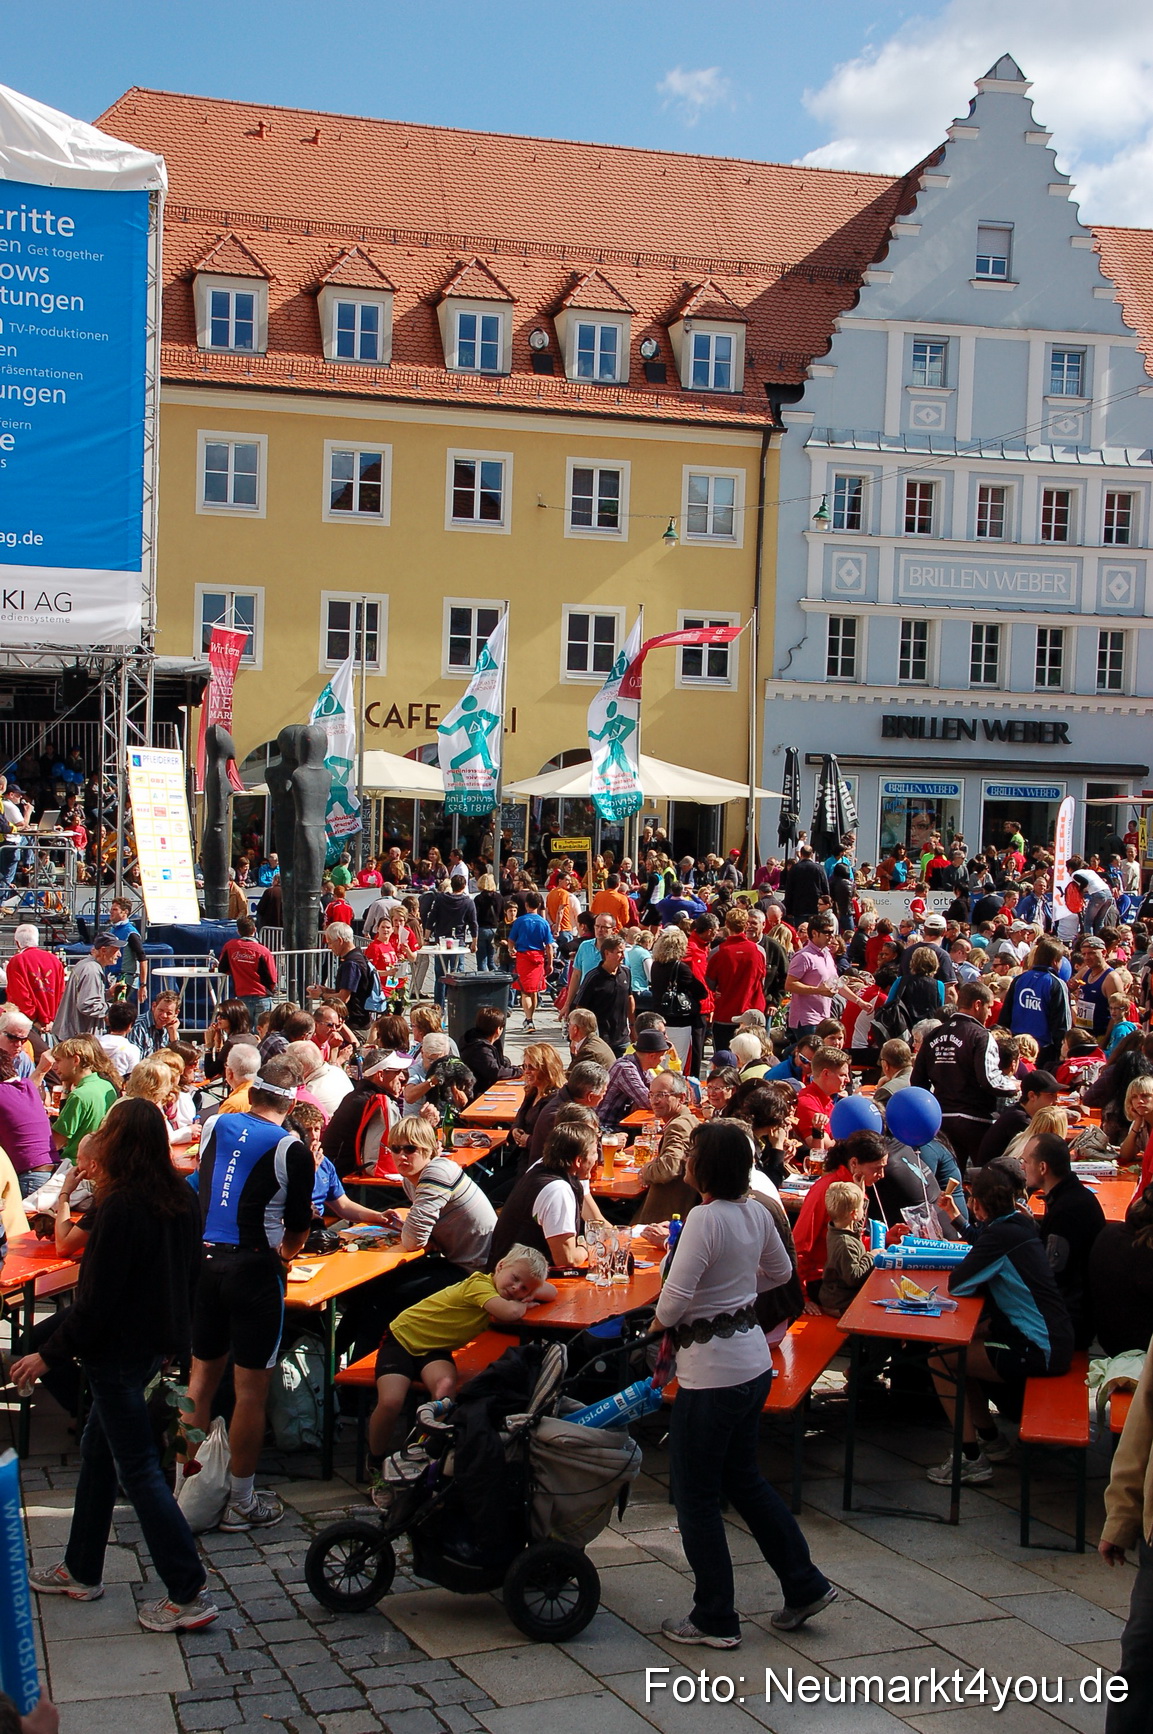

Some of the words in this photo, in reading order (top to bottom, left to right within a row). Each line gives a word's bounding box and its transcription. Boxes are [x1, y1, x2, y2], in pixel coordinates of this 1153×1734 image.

[27, 244, 49, 256] Get
[52, 247, 104, 262] together
[0, 263, 50, 283] ows
[9, 322, 109, 341] TV-Produktionen
[1, 364, 84, 380] räsentationen
[909, 566, 989, 590] BRILLEN
[993, 571, 1067, 594] WEBER
[3, 589, 25, 610] KI
[34, 591, 72, 613] AG
[365, 702, 441, 730] CAFE
[881, 715, 978, 742] BRILLEN
[982, 719, 1073, 745] WEBER
[888, 784, 923, 794] BRILLEN
[925, 785, 955, 795] WEBER
[990, 787, 1024, 796] BRILLEN
[1026, 788, 1057, 798] WEBER
[238, 1128, 249, 1143] LA
[220, 1149, 241, 1207] CARRERA
[3, 1498, 41, 1713] www.maxi-dsl.de
